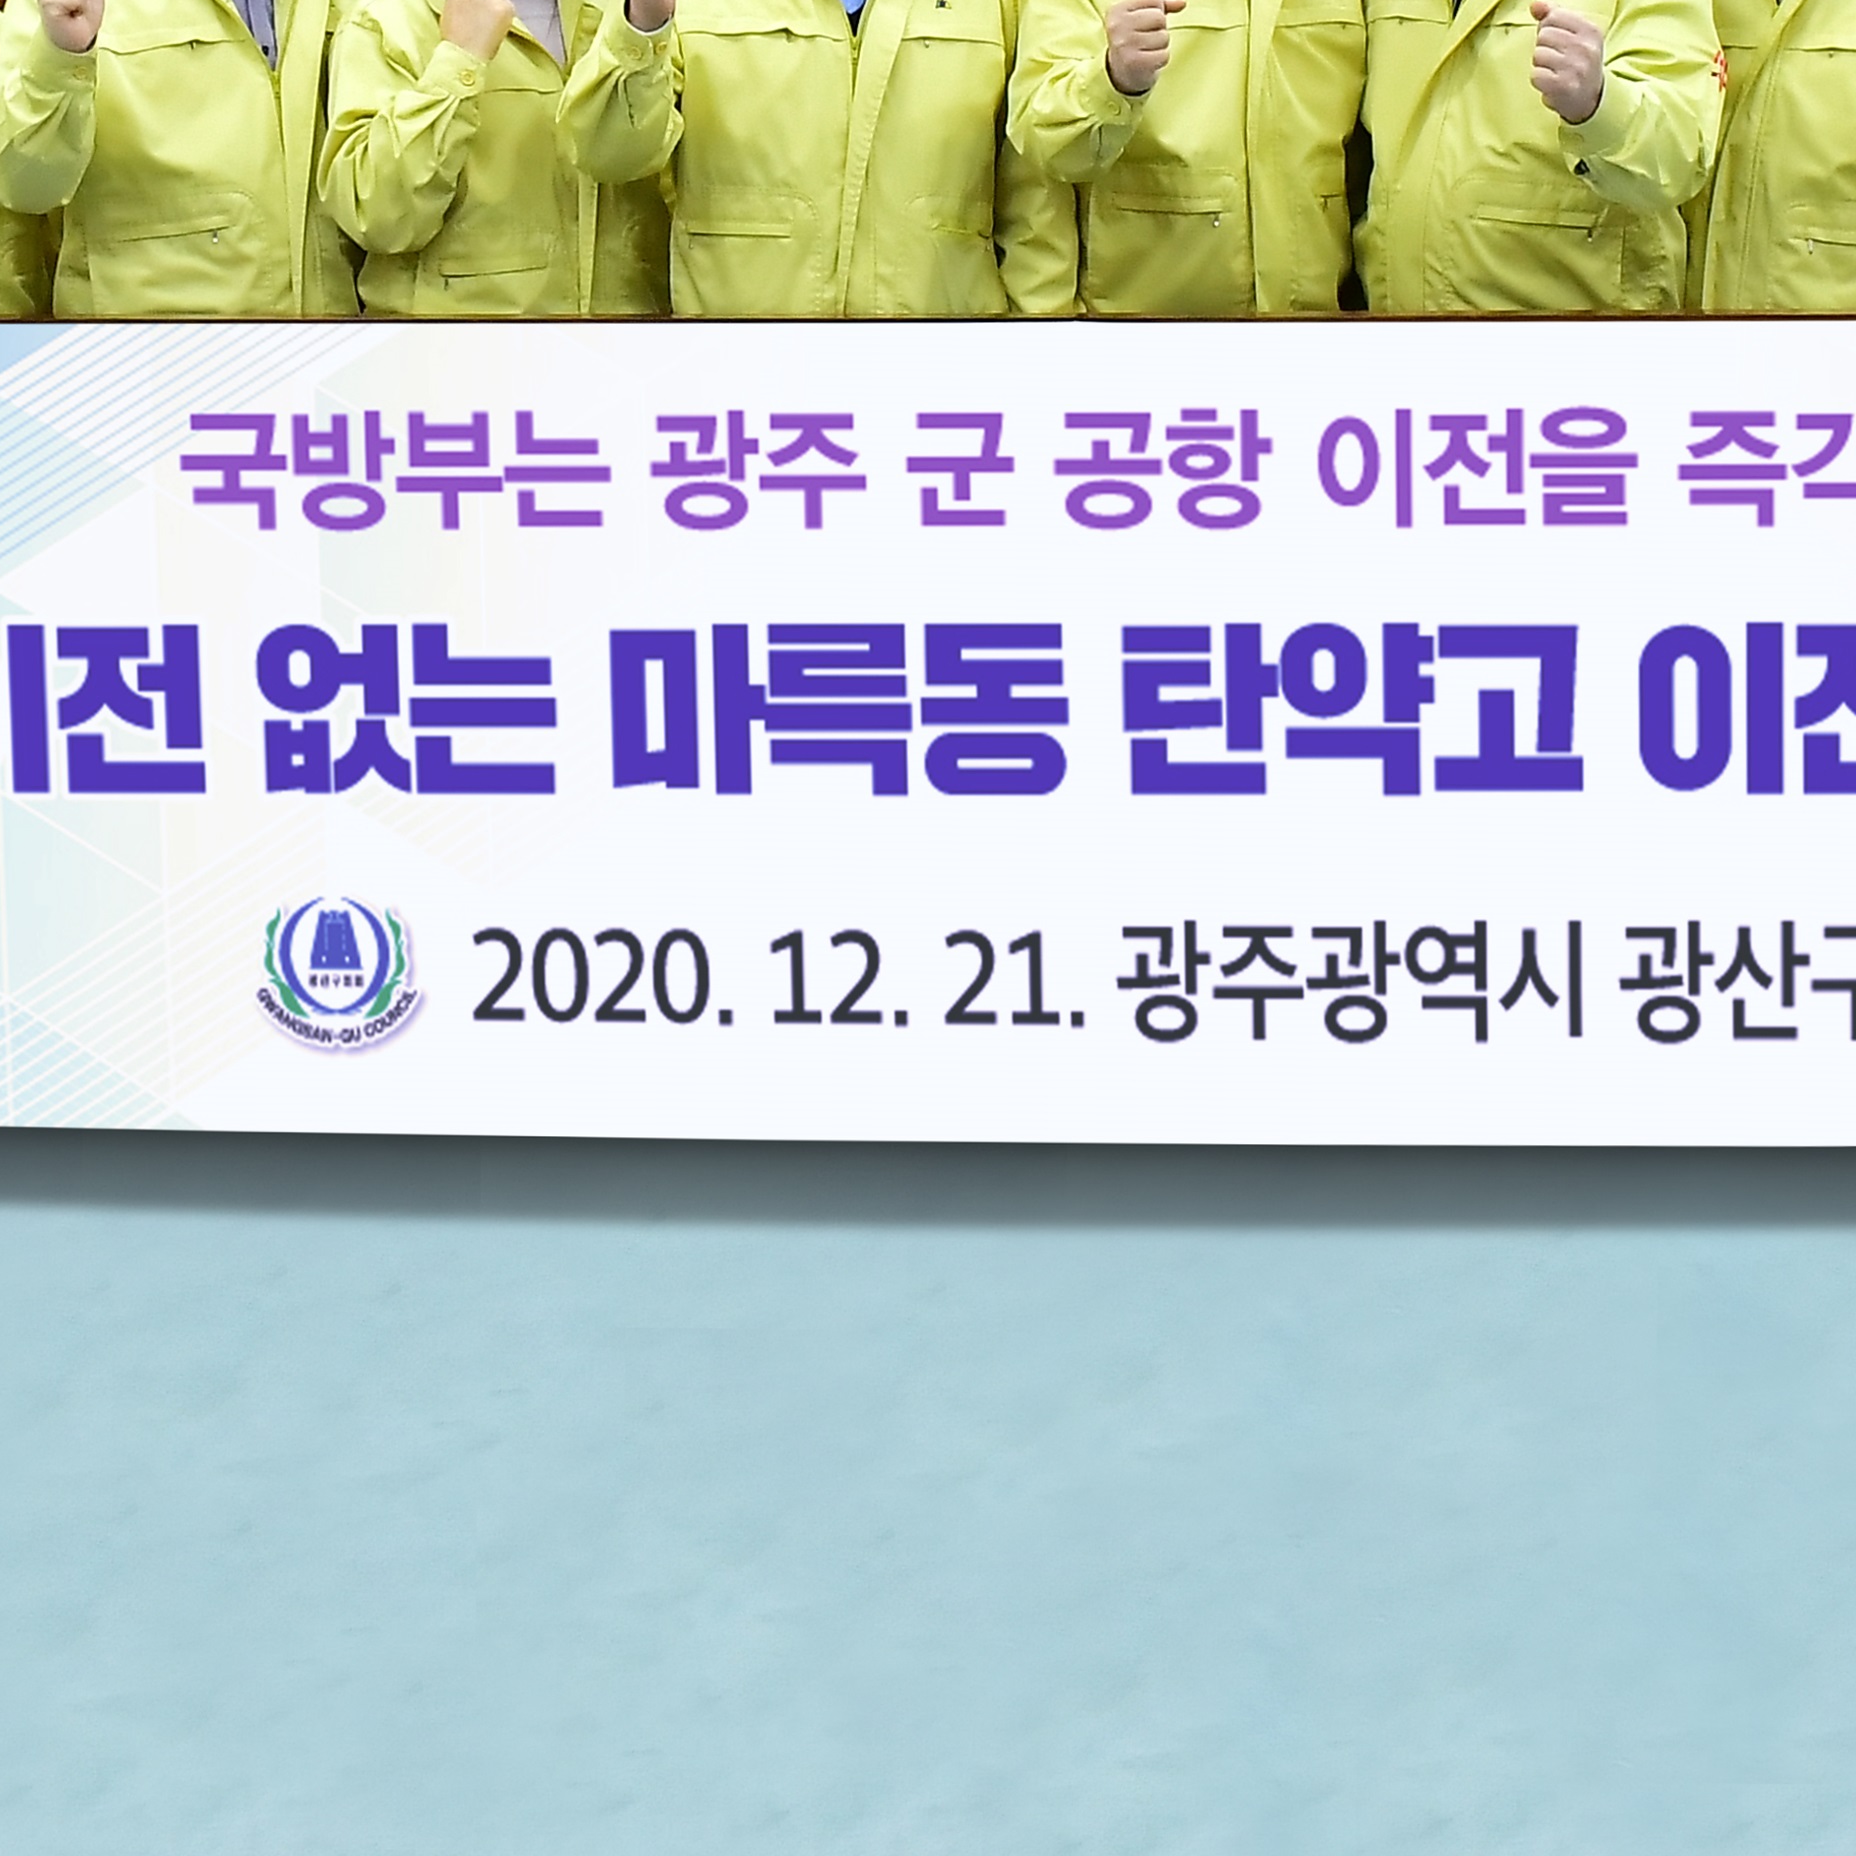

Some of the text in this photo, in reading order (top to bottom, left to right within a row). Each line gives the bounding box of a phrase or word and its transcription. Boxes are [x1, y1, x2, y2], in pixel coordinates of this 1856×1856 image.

[181, 411, 610, 530] 국방부는
[651, 411, 866, 530] 광주
[907, 413, 1014, 526] 군
[1055, 409, 1271, 529] 공항
[1318, 407, 1637, 527] 이전을
[257, 624, 557, 794] 없는
[610, 624, 1068, 796] 마륵동
[1122, 622, 1584, 796] 탄약고
[256, 987, 418, 1044] GWANGSAN-GU COUNCIL
[474, 928, 732, 1025] 2020.
[772, 930, 907, 1025] 12.
[946, 931, 1083, 1026] 21.
[1117, 921, 1581, 1042] 광주광역시
